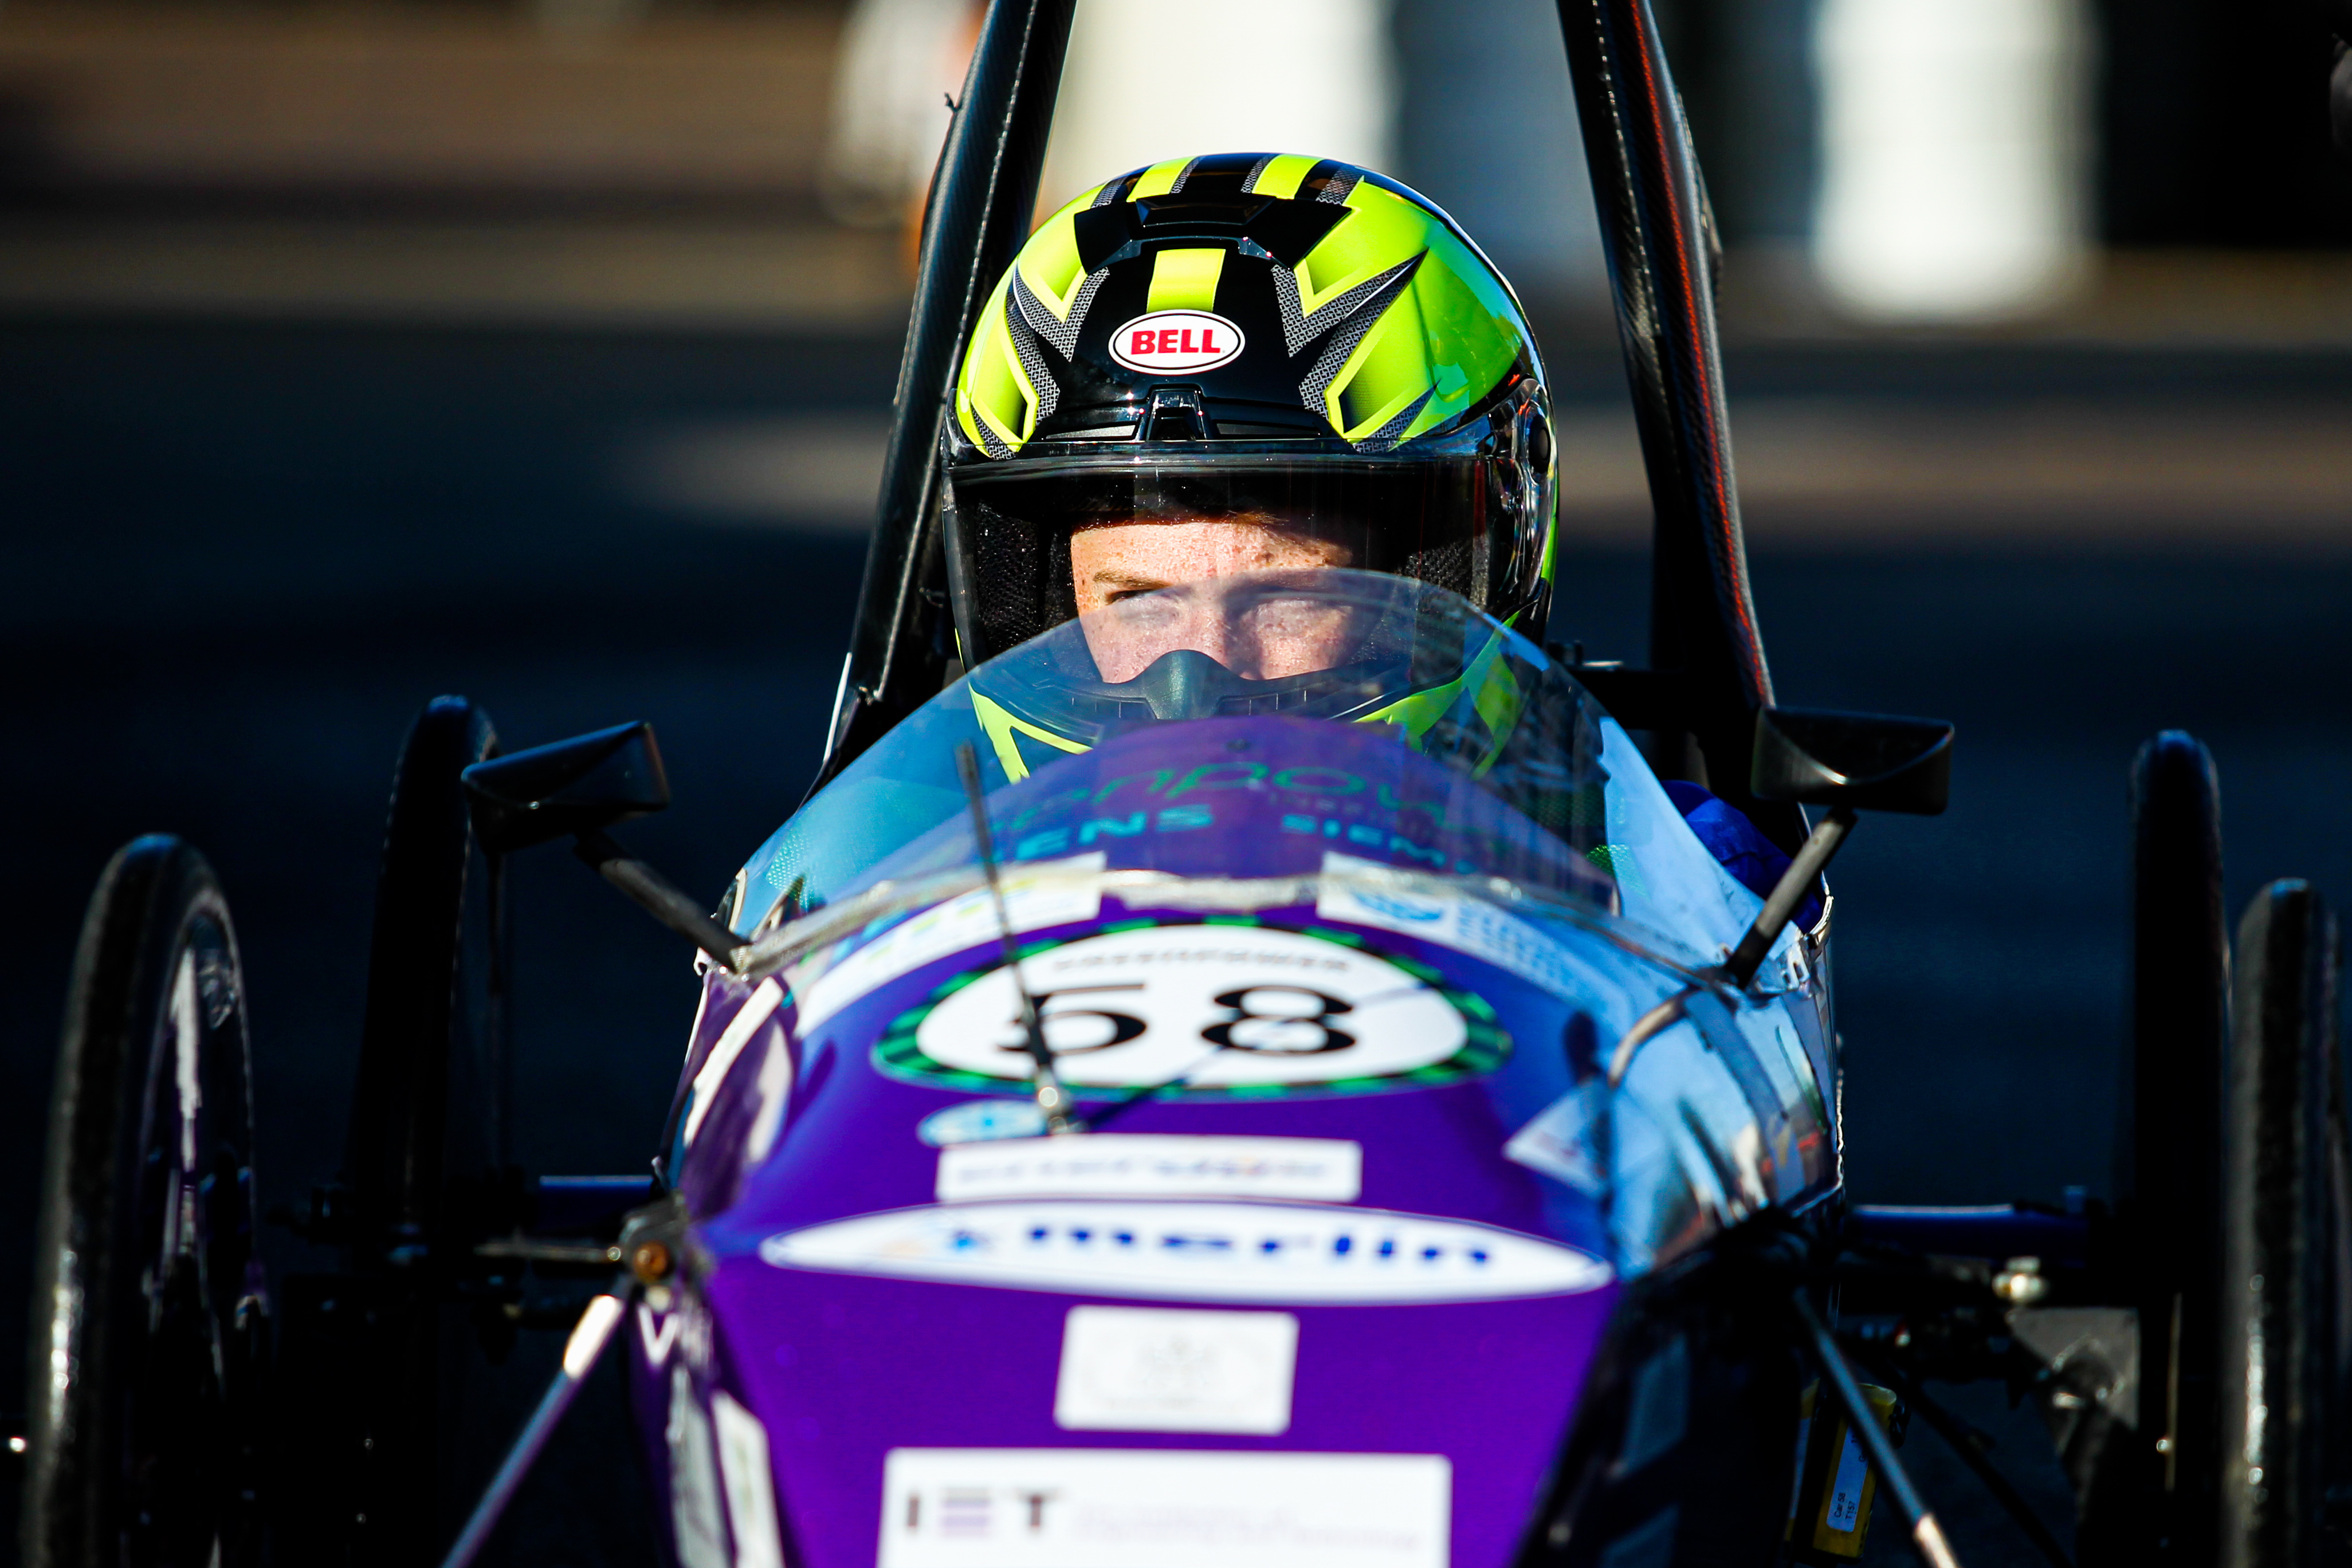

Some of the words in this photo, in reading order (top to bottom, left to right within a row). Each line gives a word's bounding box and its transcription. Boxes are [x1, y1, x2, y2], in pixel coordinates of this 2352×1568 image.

[1131, 329, 1221, 355] BELL
[997, 984, 1357, 1055] 58
[1027, 1224, 1493, 1265] merlin
[907, 1487, 1063, 1536] IET
[1834, 1504, 1843, 1518] Car
